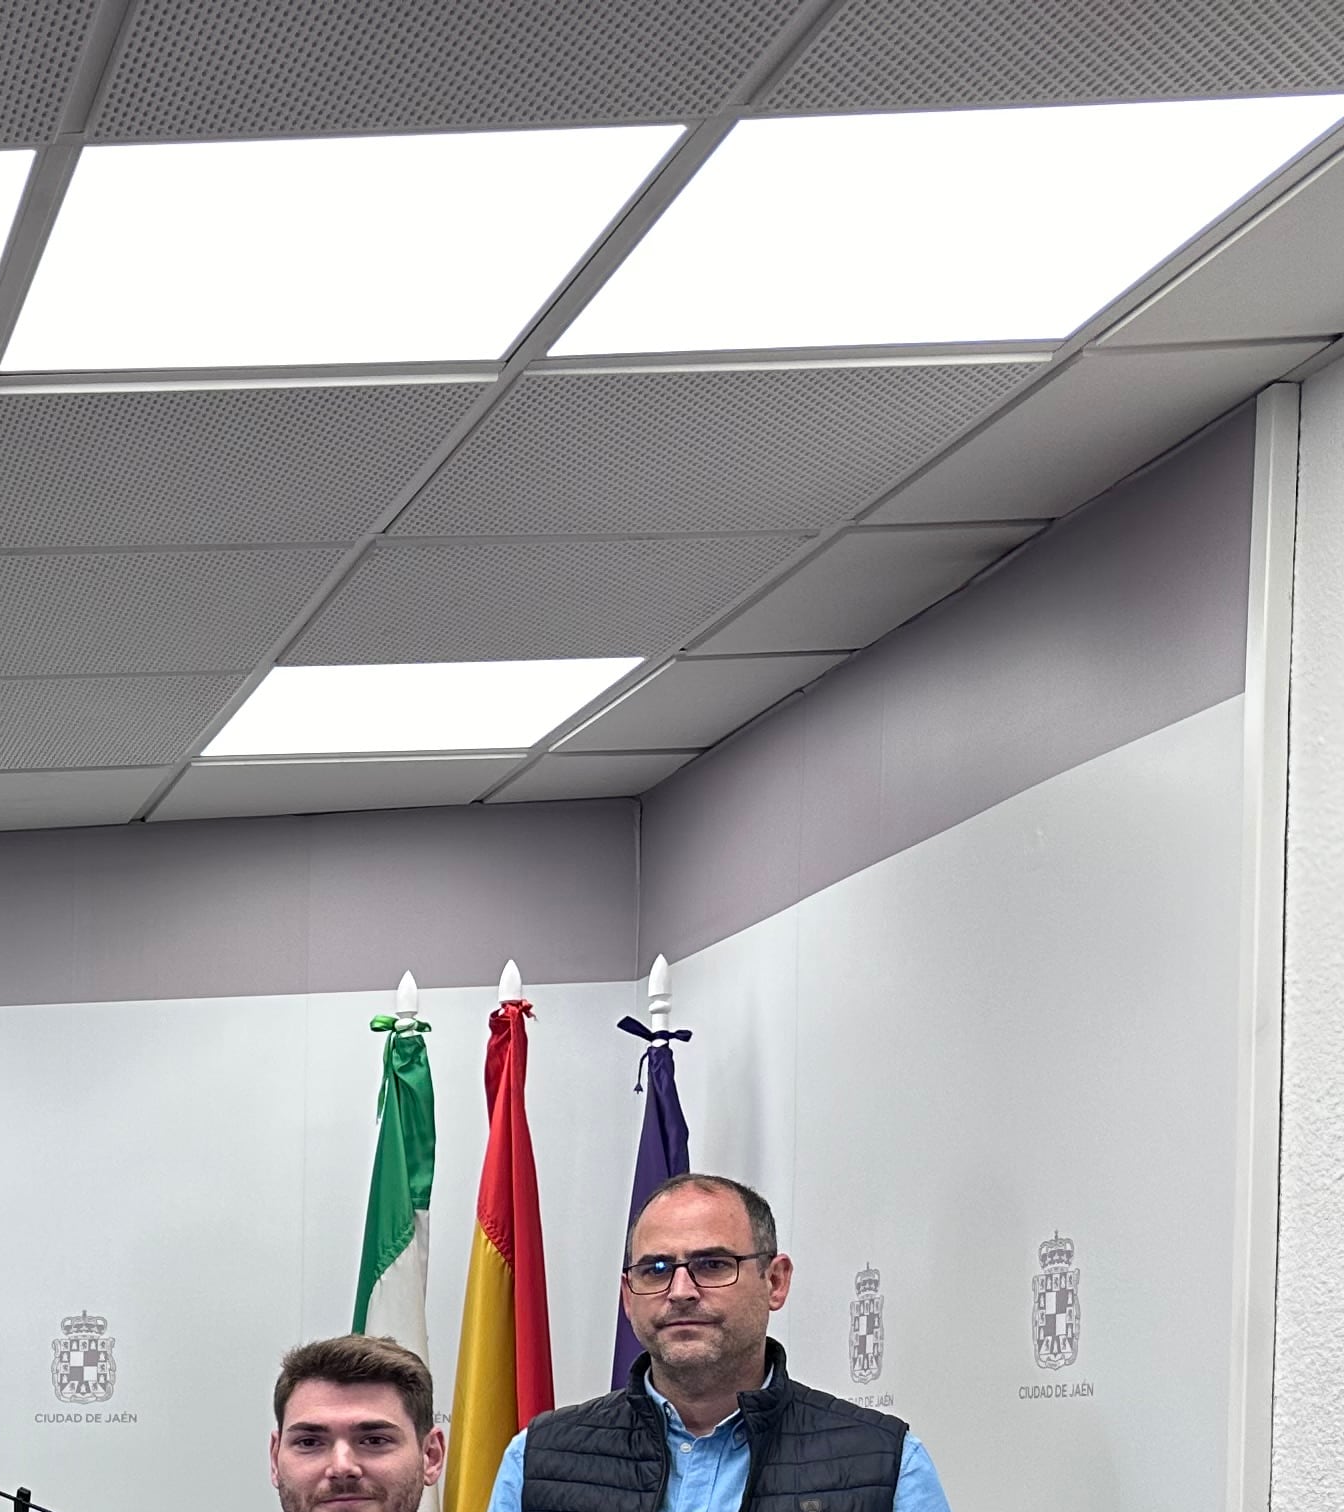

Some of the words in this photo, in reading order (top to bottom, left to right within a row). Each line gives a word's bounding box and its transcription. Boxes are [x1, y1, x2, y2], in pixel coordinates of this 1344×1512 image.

[1019, 1385, 1053, 1400] CIUDAD
[1056, 1385, 1068, 1398] DE
[1070, 1380, 1094, 1397] JAÉN
[35, 1414, 82, 1423] CIUDAD
[86, 1414, 102, 1423] DE
[105, 1411, 138, 1423] JAÉN
